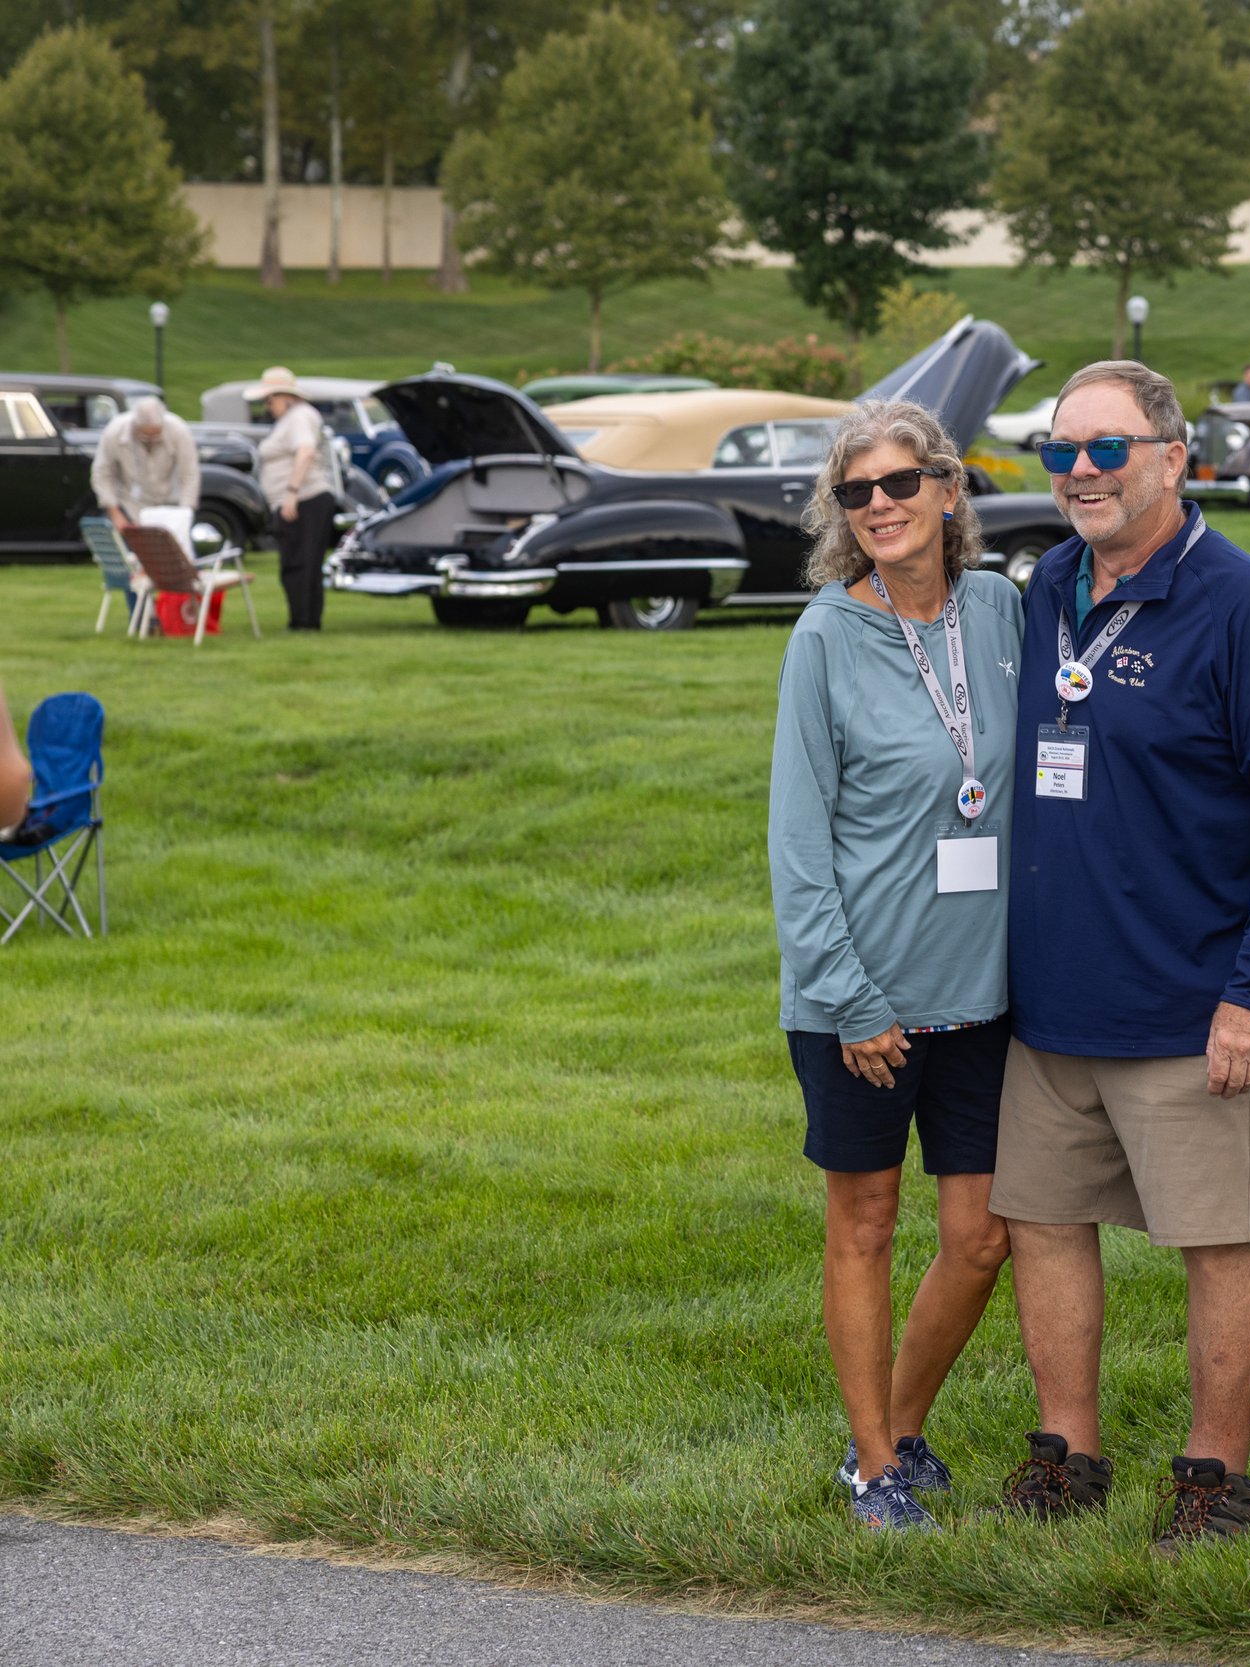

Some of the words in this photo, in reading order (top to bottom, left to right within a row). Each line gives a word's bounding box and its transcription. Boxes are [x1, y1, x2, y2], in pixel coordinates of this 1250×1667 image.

[950, 635, 959, 667] Auctions
[1082, 641, 1103, 667] Auction
[935, 689, 951, 719] Auctions
[1053, 772, 1066, 781] Noel
